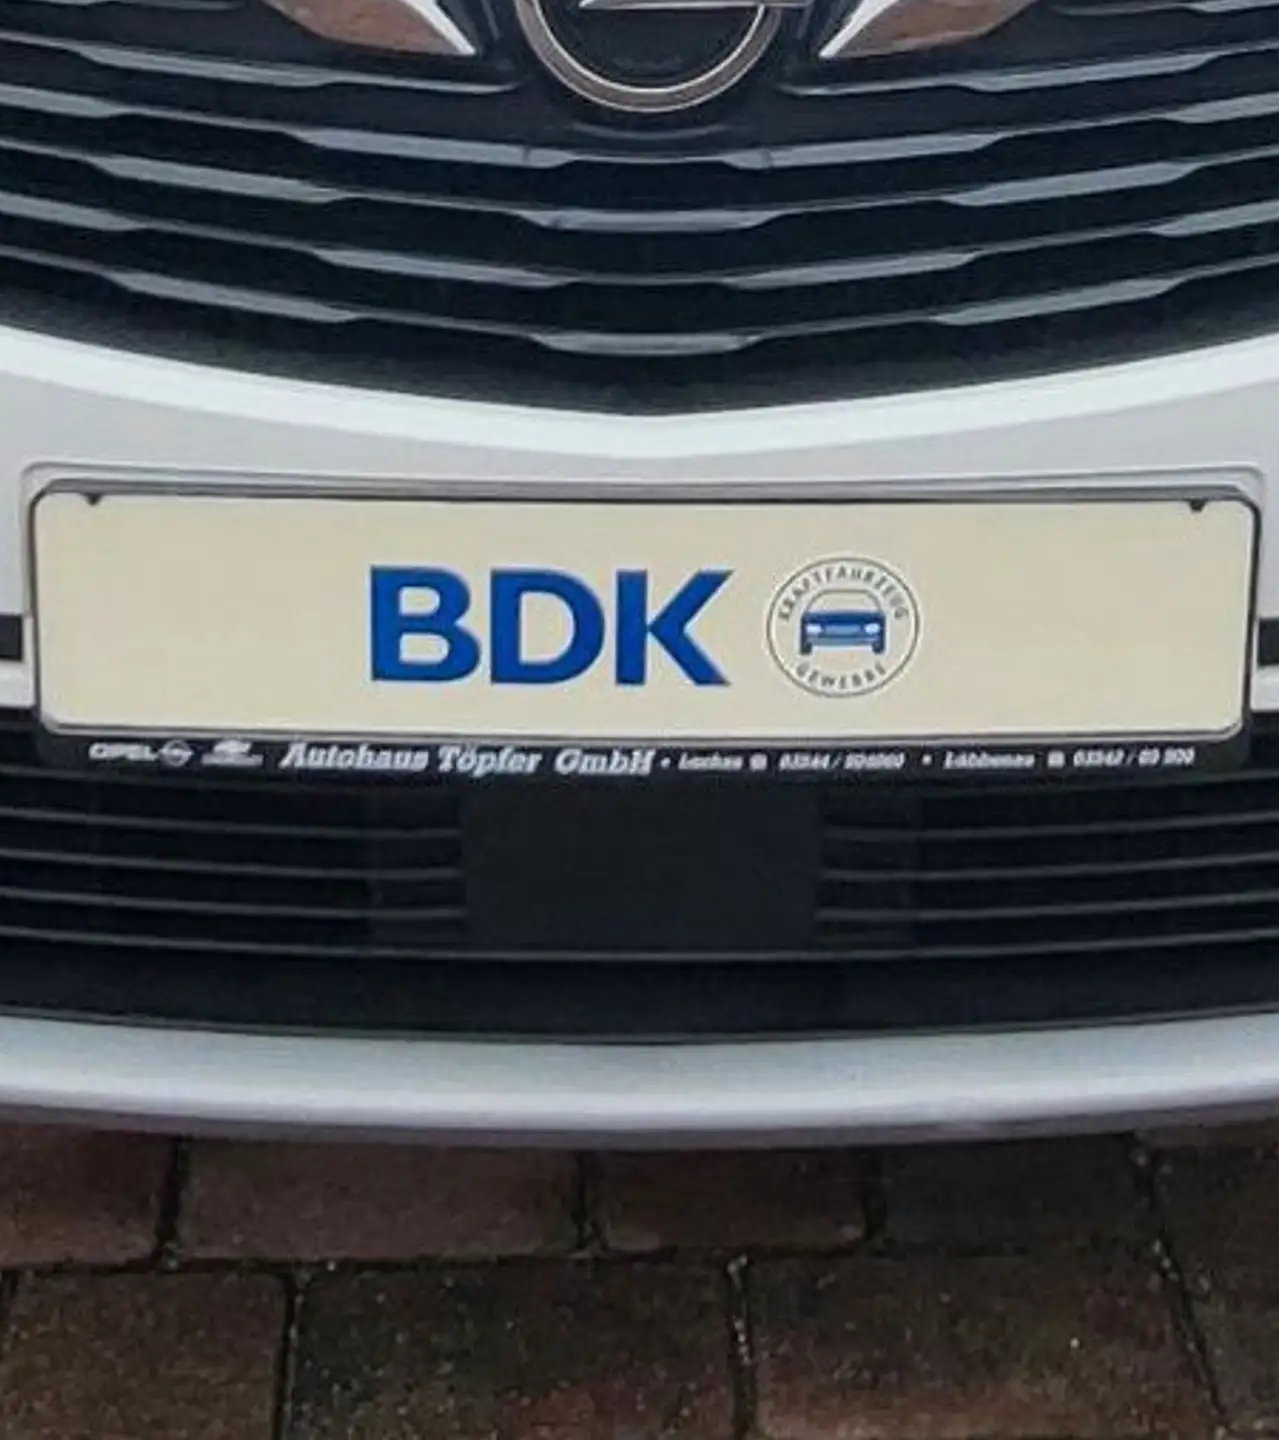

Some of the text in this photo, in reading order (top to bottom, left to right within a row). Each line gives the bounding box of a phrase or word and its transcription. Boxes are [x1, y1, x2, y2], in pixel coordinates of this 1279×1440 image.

[370, 565, 733, 687] BDK
[279, 741, 430, 772] Autohaus
[437, 742, 543, 779] Töpfer
[553, 746, 656, 776] GmbH
